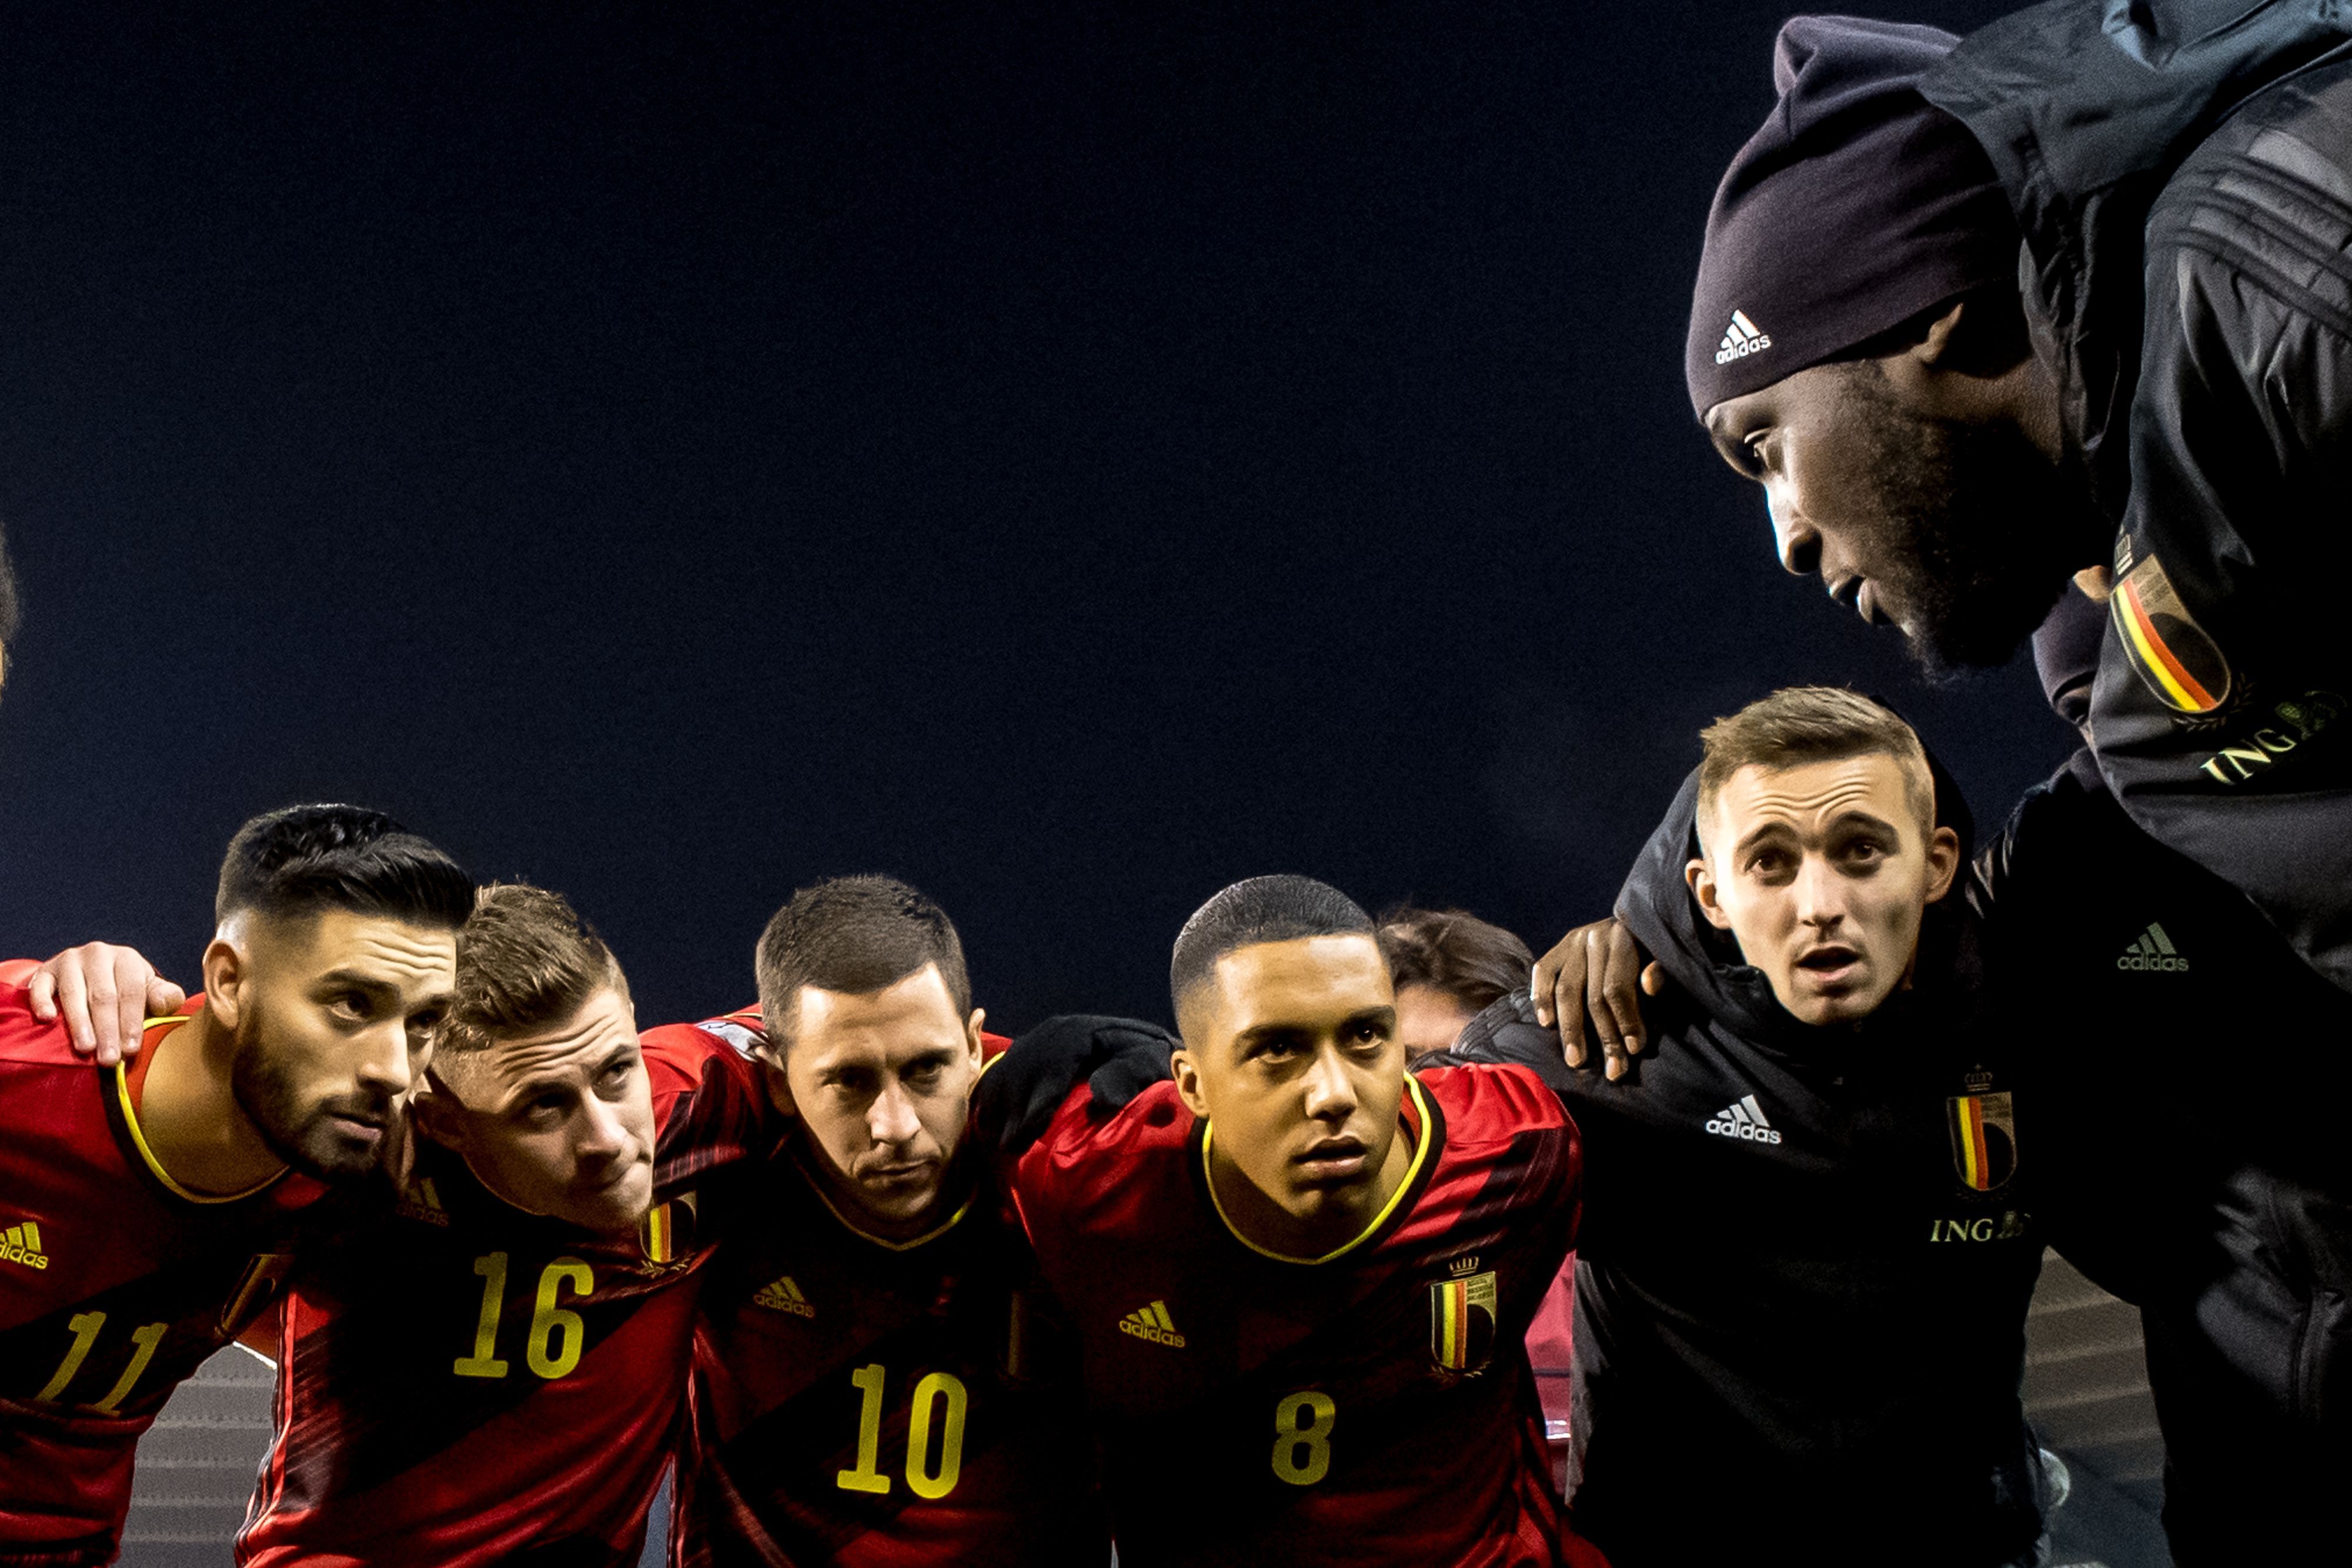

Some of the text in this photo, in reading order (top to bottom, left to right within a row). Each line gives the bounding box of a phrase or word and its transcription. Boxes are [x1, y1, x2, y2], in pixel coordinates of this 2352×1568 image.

[1715, 335, 1771, 365] adidas
[2199, 728, 2297, 786] ING
[2117, 952, 2189, 972] adidas
[1705, 1119, 1783, 1144] adidas
[1929, 1218, 1994, 1242] ING
[453, 1251, 594, 1379] 16
[753, 1294, 815, 1318] adidas
[1119, 1319, 1186, 1348] adidas
[34, 1310, 169, 1417] 11
[837, 1363, 968, 1499] 10
[1271, 1390, 1336, 1486] 8
